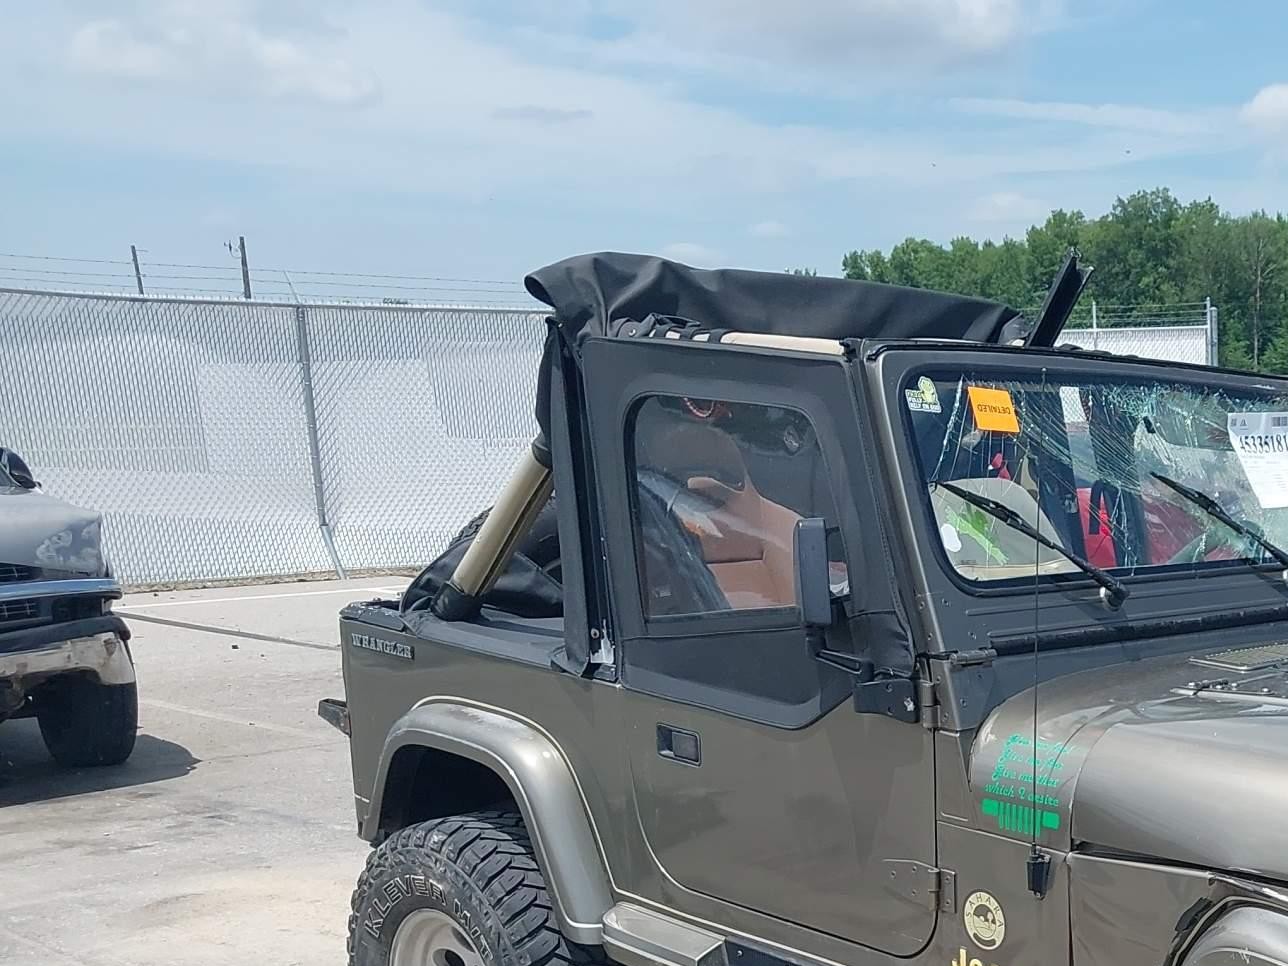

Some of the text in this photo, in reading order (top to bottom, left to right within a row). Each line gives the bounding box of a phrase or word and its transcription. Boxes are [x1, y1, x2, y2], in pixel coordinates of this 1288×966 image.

[1240, 434, 1288, 454] 45335181
[352, 633, 412, 659] WRANGLER
[364, 875, 446, 938] KLEVER
[966, 893, 1004, 928] SAHARA
